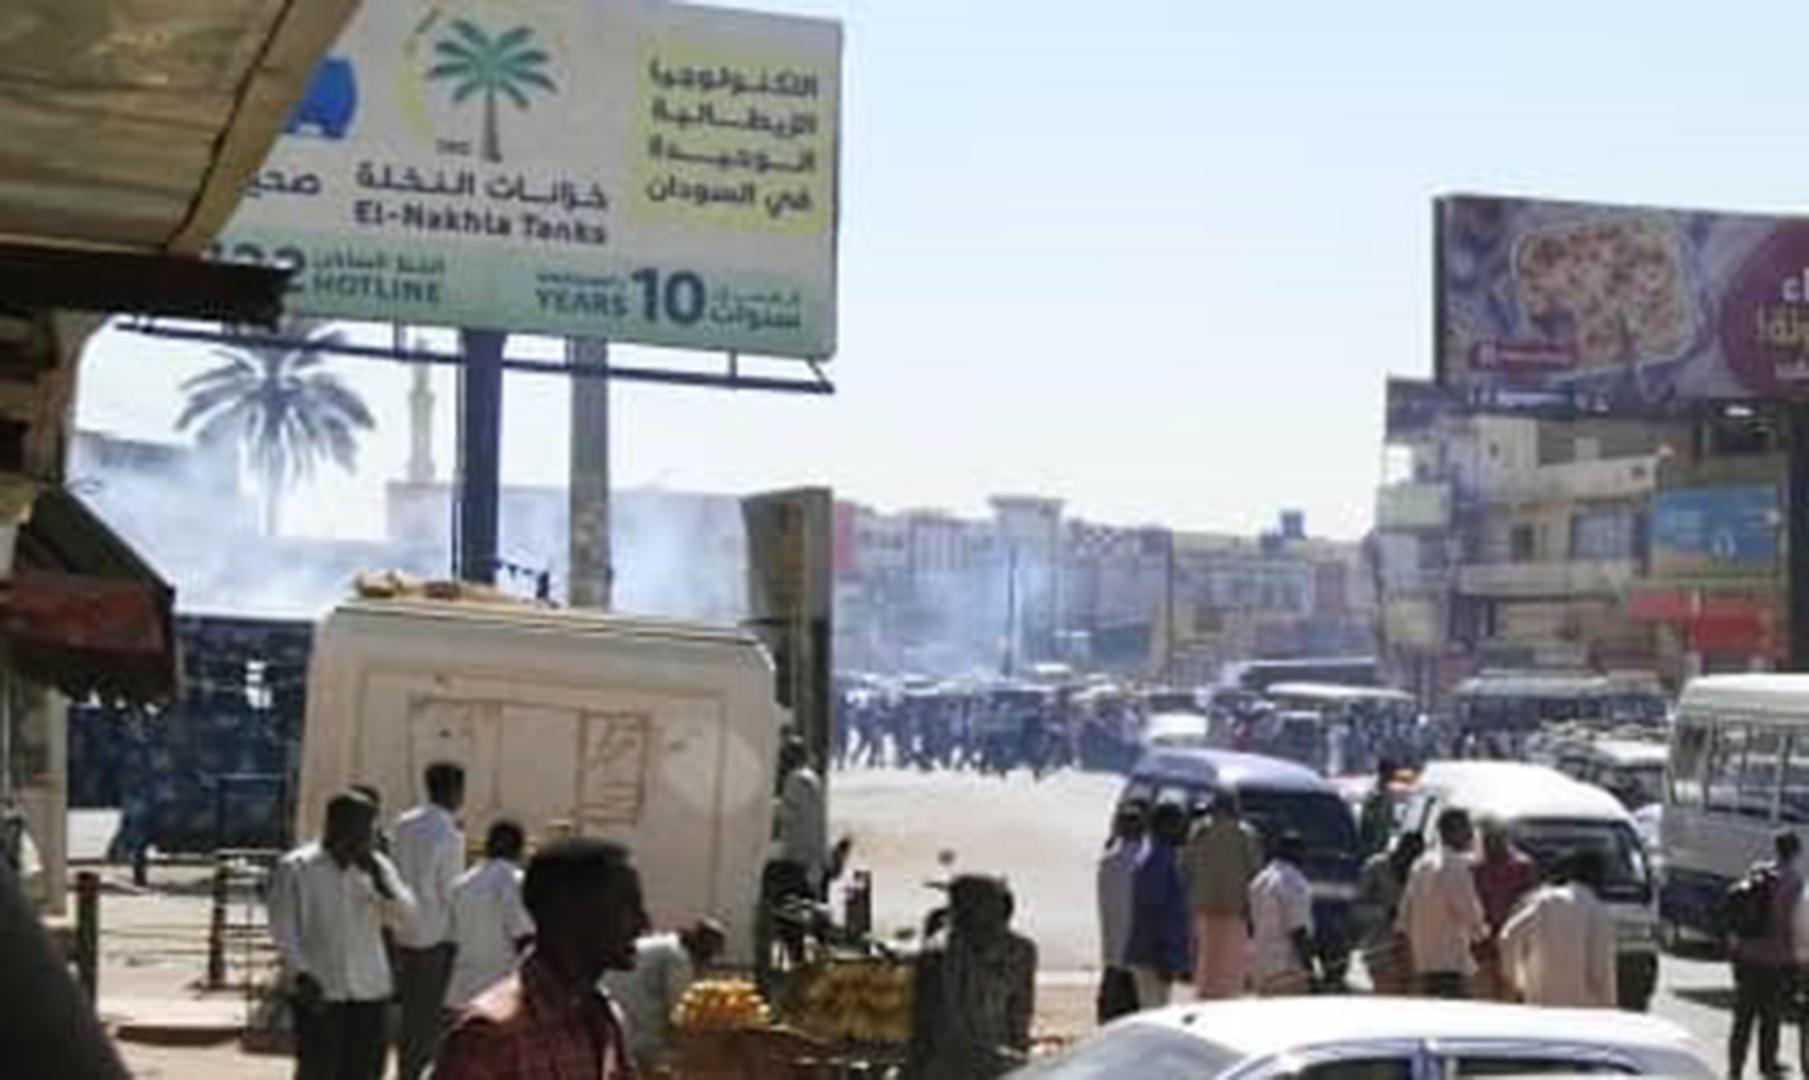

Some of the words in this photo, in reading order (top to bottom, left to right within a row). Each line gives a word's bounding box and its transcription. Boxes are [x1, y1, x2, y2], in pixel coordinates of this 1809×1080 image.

[648, 58, 818, 98] التكنولوجيا
[648, 134, 815, 176] الوحيدة
[244, 168, 322, 199] صحي
[356, 161, 471, 195] النخلة
[646, 173, 756, 206] السودان
[764, 187, 812, 219] في
[354, 200, 509, 236] El-Nakhla
[521, 213, 606, 245] Tanks
[312, 272, 442, 302] HOTLINE
[535, 287, 630, 317] YEARS
[632, 267, 707, 327] 10
[710, 303, 801, 332] سنوات
